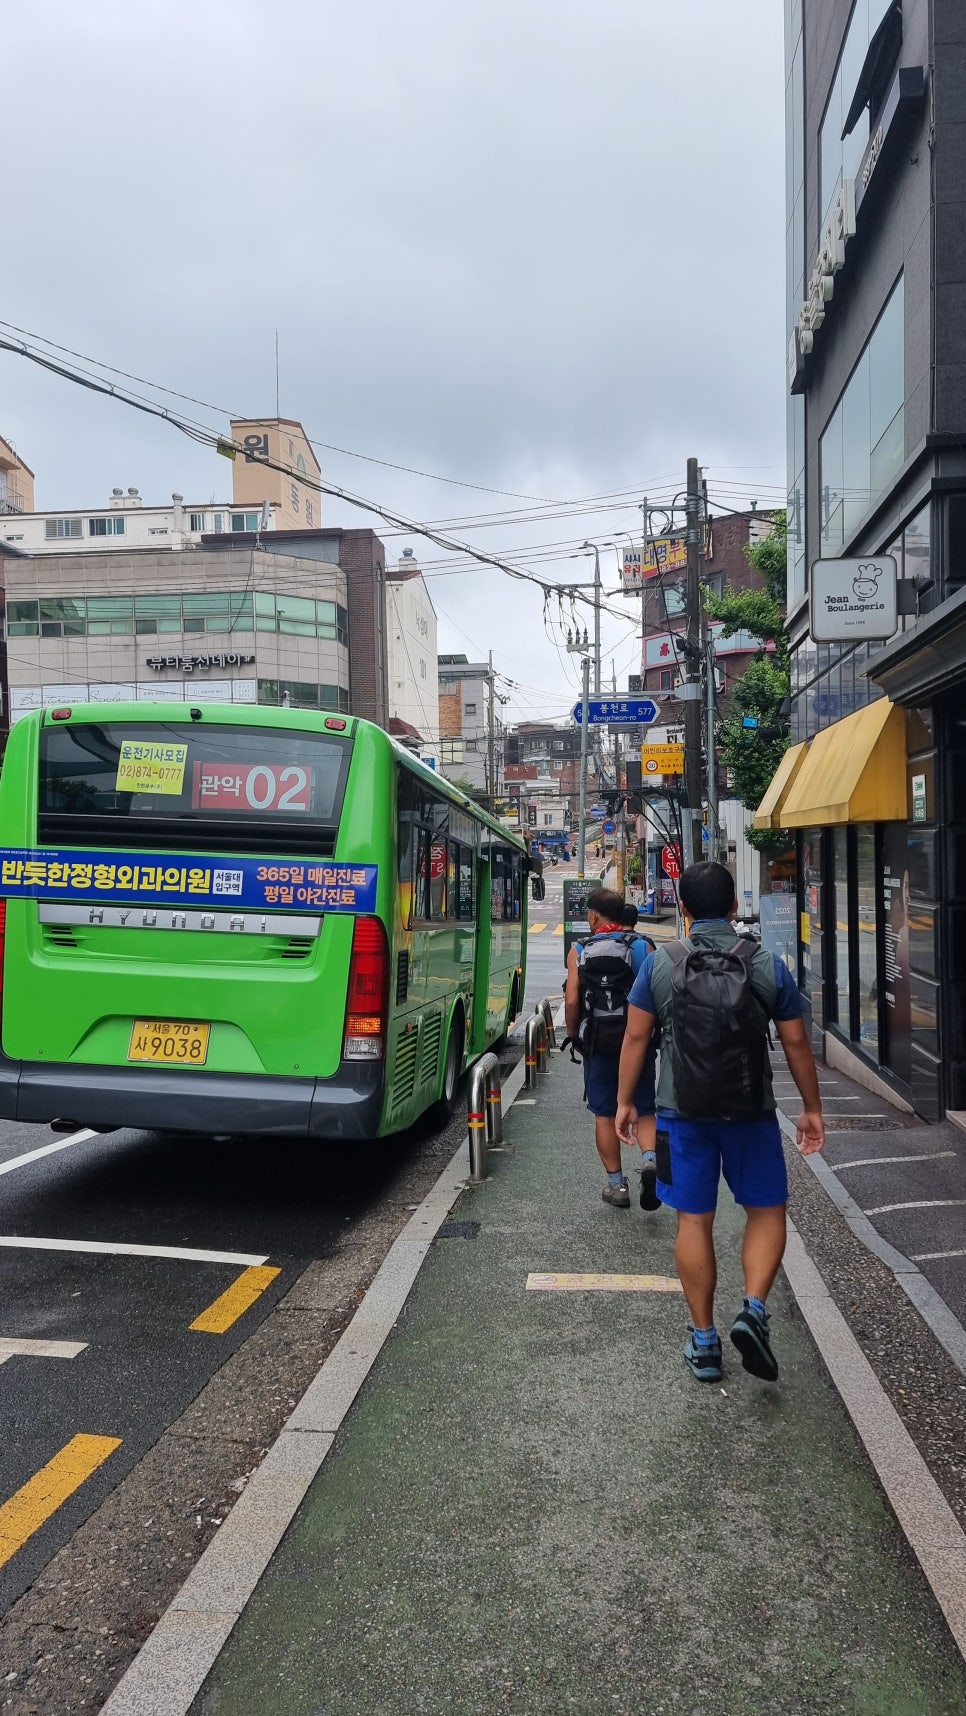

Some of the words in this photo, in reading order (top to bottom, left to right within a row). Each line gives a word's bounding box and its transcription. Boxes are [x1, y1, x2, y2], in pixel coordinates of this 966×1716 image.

[825, 595, 849, 604] Jean
[827, 602, 885, 613] Boulangerie
[149, 653, 242, 672] 뷰티룸선데이
[600, 703, 629, 714] 봉천로
[638, 707, 653, 716] 577
[593, 714, 637, 723] Bongcheon-ro
[121, 745, 185, 763] 운전기사모집
[119, 764, 182, 781] 02)874-0777
[201, 775, 242, 797] 관악
[245, 765, 306, 810] 02
[2, 860, 211, 894] 반듯한정형외과의원
[216, 871, 241, 883] 서울대
[256, 866, 304, 884] 365일
[308, 869, 366, 886] 매일진료
[215, 882, 240, 893] 입구역
[264, 886, 294, 904] 평일
[297, 888, 356, 906] 야간진료
[88, 907, 266, 933] HYUNDAI
[152, 1023, 170, 1034] 서울
[173, 1024, 190, 1035] 70
